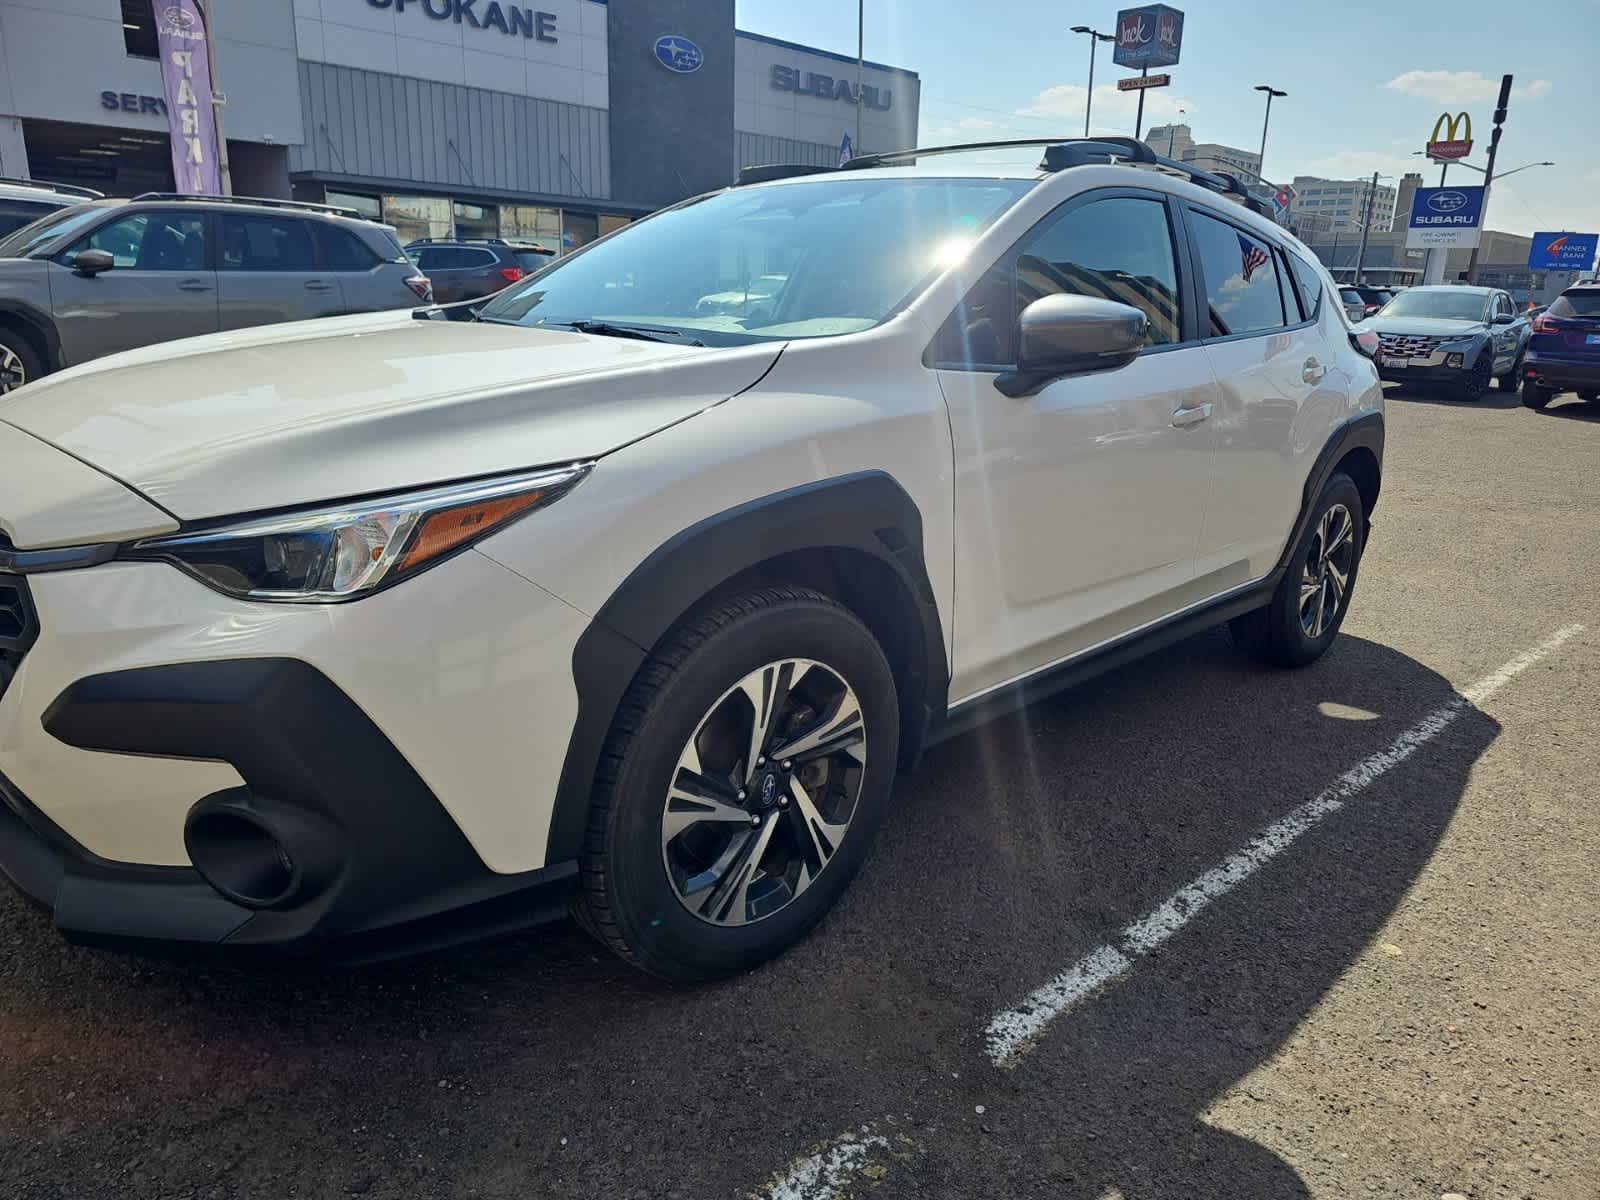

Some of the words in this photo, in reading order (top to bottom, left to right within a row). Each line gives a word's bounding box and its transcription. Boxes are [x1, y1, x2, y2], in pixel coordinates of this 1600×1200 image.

[366, 0, 559, 44] OKANE
[1119, 15, 1153, 46] Jack
[770, 63, 892, 112] SUBARU
[1415, 215, 1474, 224] SUBARU
